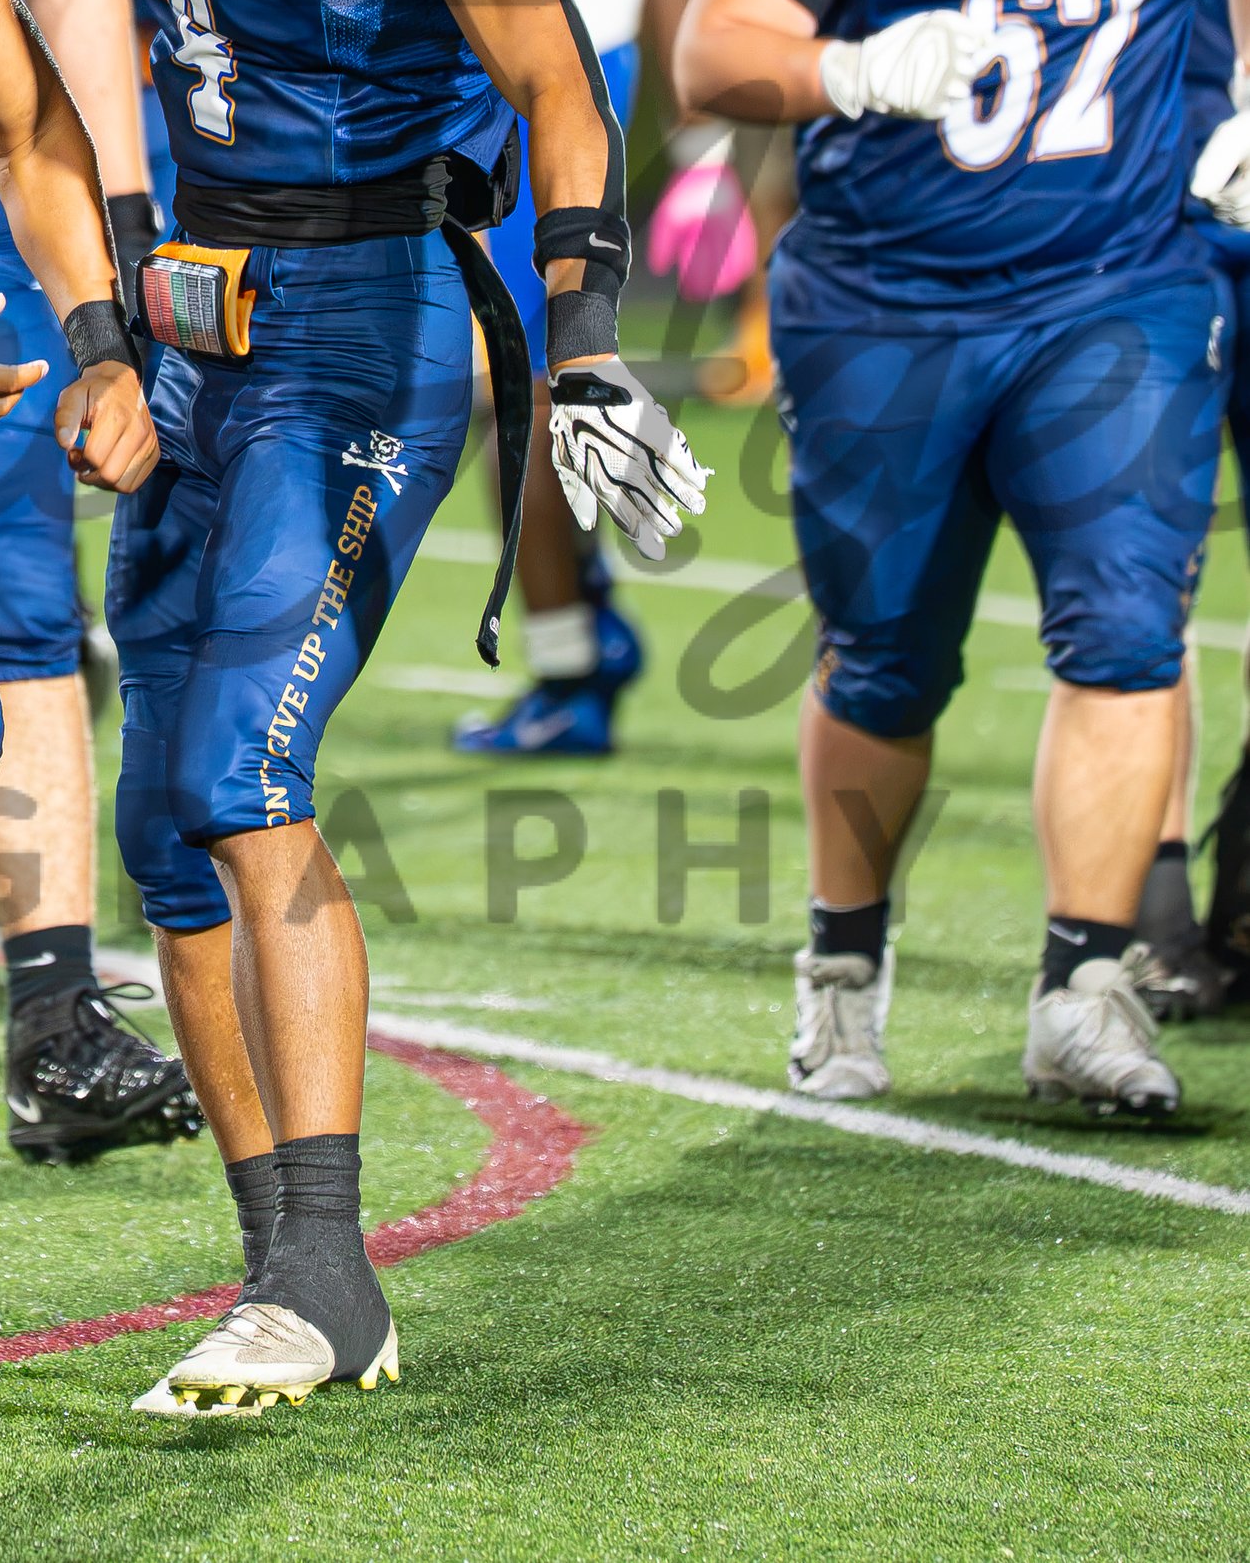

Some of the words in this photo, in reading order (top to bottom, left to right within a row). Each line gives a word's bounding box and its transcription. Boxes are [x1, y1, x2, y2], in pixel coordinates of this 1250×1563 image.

[292, 631, 327, 684] UP
[311, 559, 355, 631] THE
[338, 484, 379, 562] SHIP
